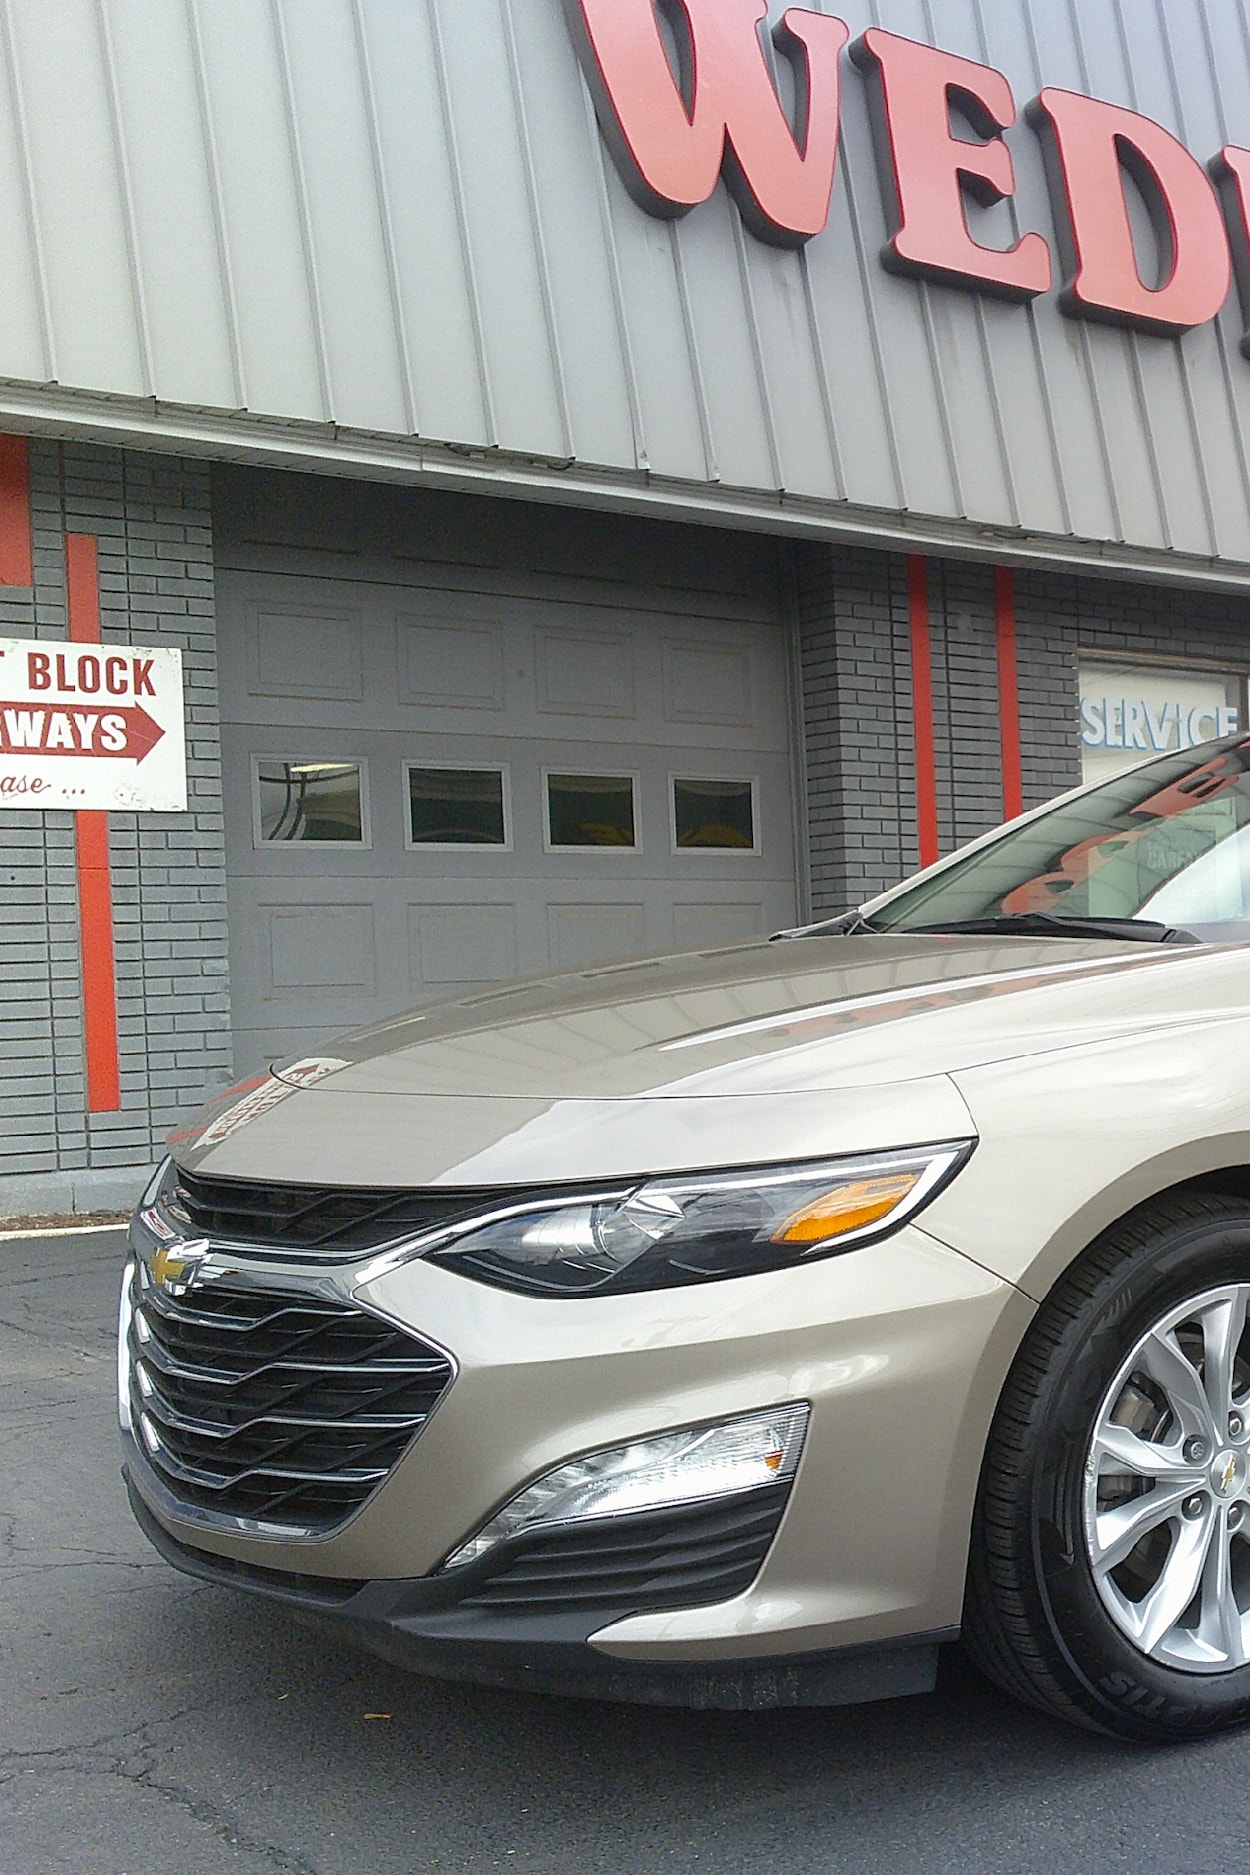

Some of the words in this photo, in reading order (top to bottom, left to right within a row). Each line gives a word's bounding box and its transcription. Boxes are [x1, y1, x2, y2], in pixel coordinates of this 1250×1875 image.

[27, 652, 157, 697] BLOCK
[0, 709, 128, 751] WAYS
[1080, 698, 1239, 751] SERVICE
